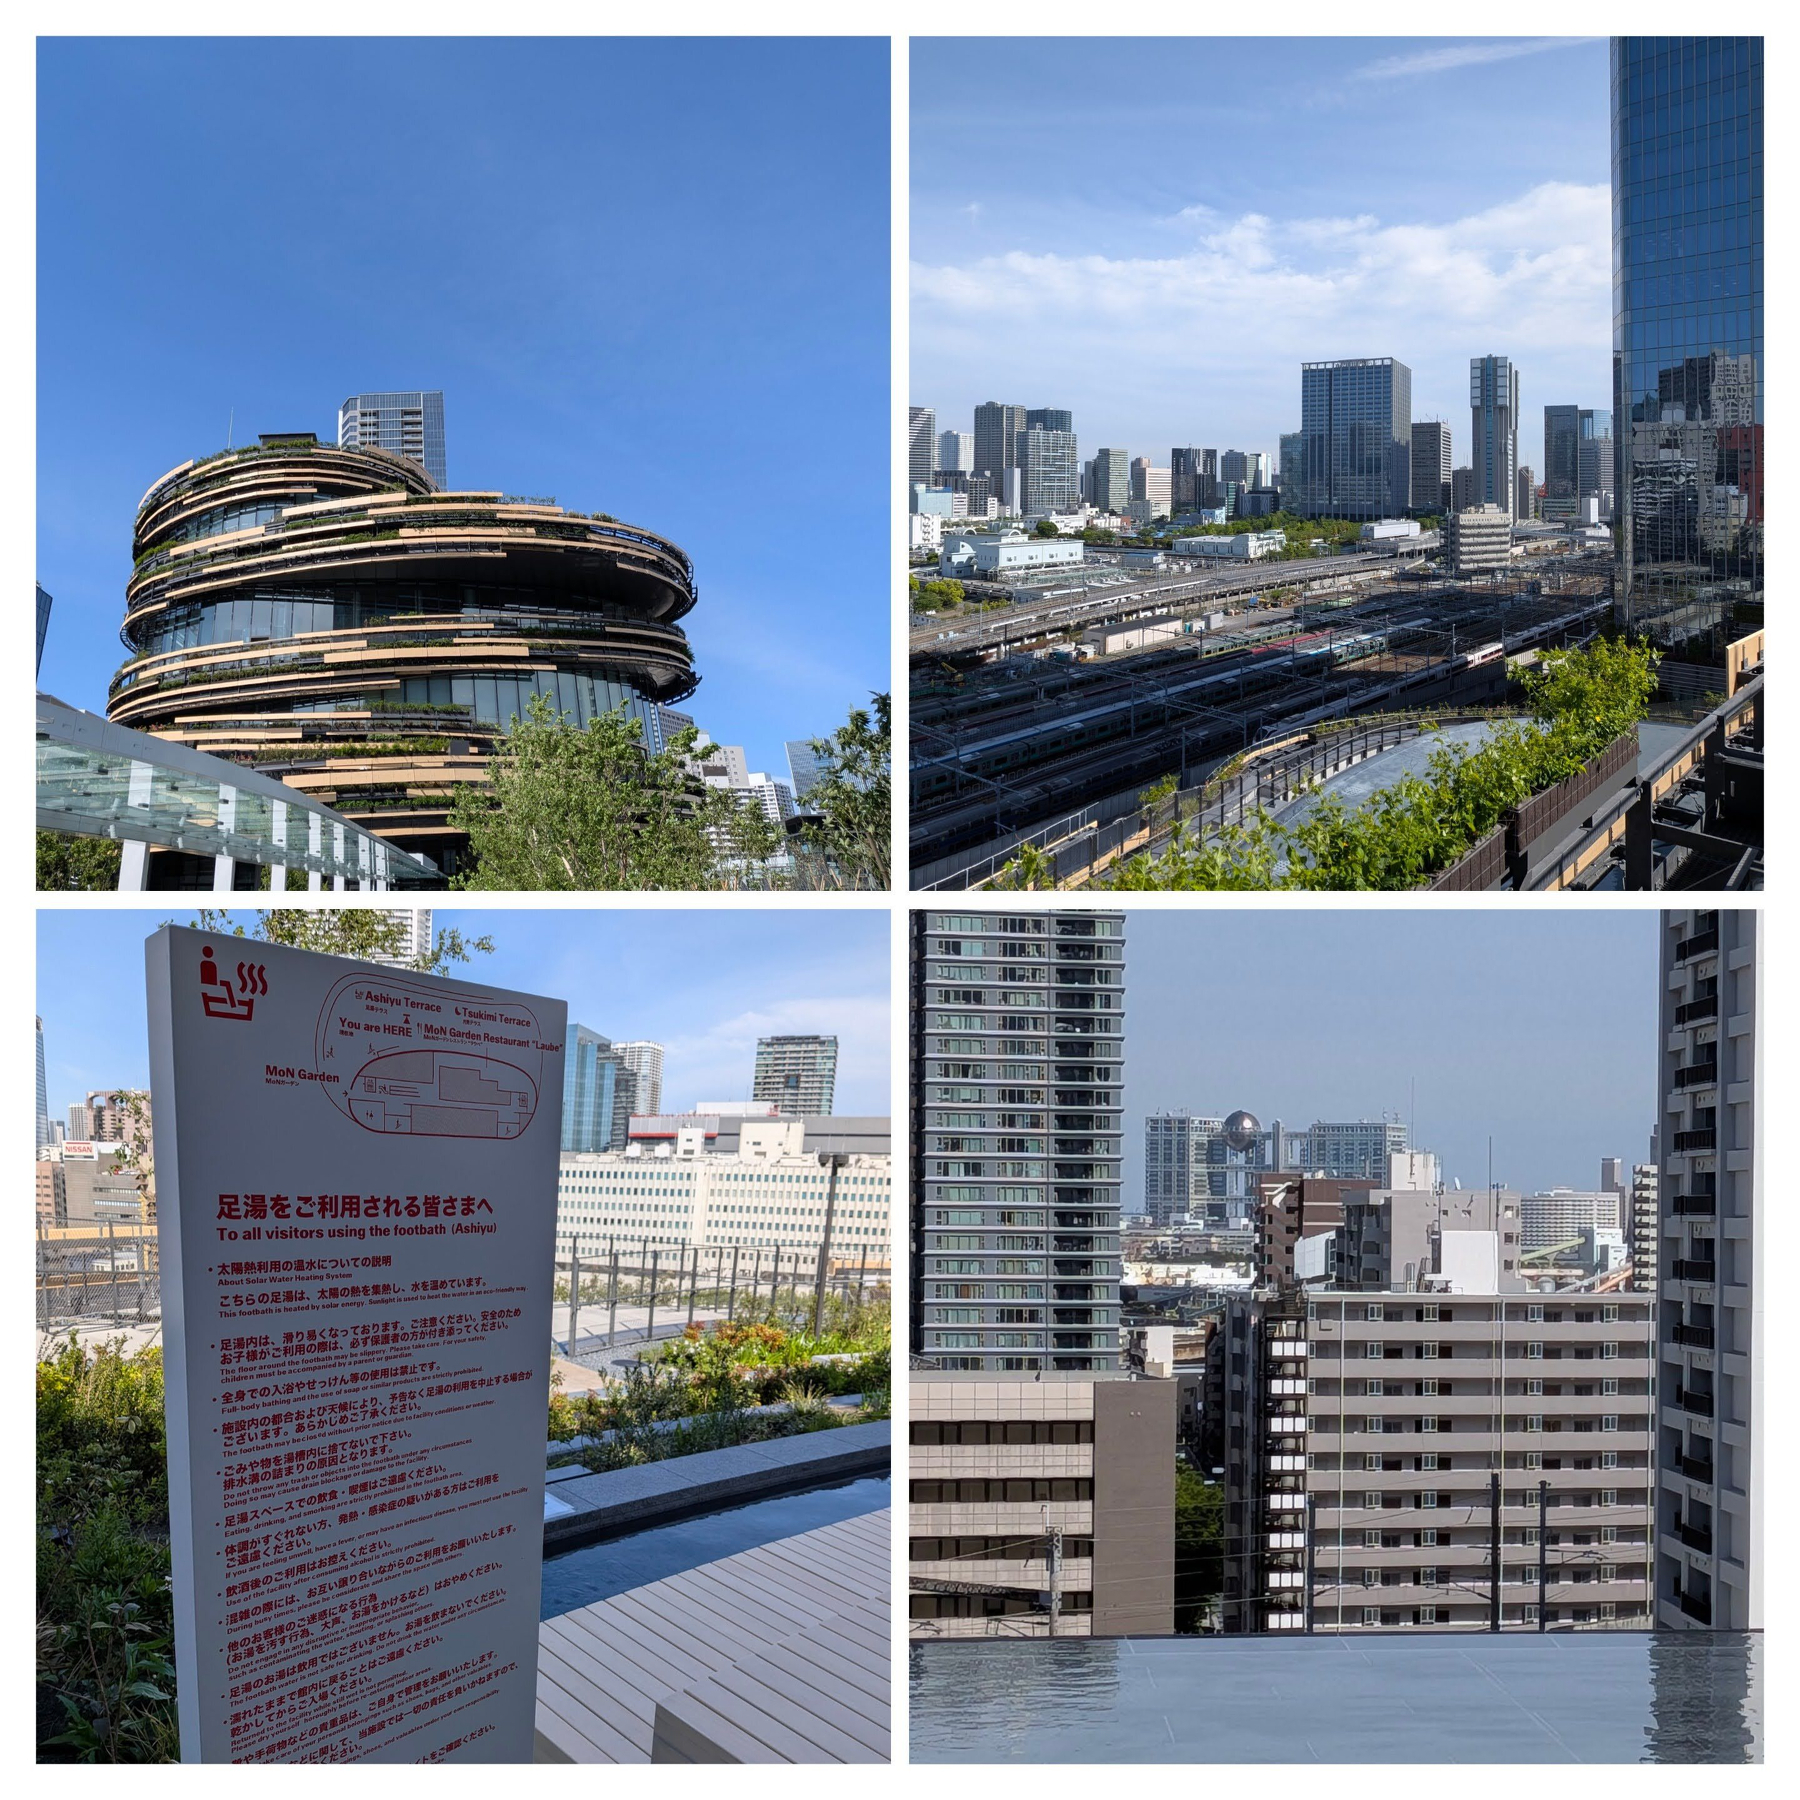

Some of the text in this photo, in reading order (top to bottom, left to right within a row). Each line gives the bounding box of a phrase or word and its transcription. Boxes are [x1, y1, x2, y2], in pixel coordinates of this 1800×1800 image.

[365, 991, 442, 1013] Ashiyu Terrace
[339, 1016, 413, 1038] You are HERE
[462, 1007, 531, 1027] Tsukimi Terrace
[424, 1023, 448, 1036] MoN
[449, 1027, 481, 1042] Garden
[483, 1032, 530, 1048] Restaurant
[265, 1064, 340, 1084] MoN Garden
[65, 1145, 93, 1154] NISSAN
[216, 1194, 493, 1220] 足湯をご利用される皆さまへ
[217, 1221, 497, 1241] To all visitors using the footbath (Ashiyu)
[217, 1279, 244, 1287] About
[245, 1277, 267, 1285] Solar
[218, 1309, 237, 1318] This
[238, 1307, 273, 1316] footbath
[283, 1304, 310, 1313] heated
[311, 1303, 320, 1311] by
[220, 1368, 236, 1376] The
[258, 1360, 286, 1370] around
[301, 1355, 333, 1364] footbath
[220, 1374, 254, 1384] children
[256, 1370, 275, 1379] must
[288, 1361, 337, 1374] accompanied
[262, 1398, 291, 1408] bathing
[292, 1394, 306, 1403] and
[335, 1388, 342, 1396] of
[222, 1450, 238, 1458] The
[239, 1442, 273, 1455] footbath
[327, 1426, 354, 1436] without
[223, 1498, 247, 1509] Doing
[260, 1492, 276, 1500] may
[277, 1486, 300, 1495] cause
[301, 1481, 319, 1490] drain
[320, 1473, 352, 1485] blockage
[237, 1489, 250, 1497] not
[252, 1485, 274, 1494] throw
[290, 1475, 310, 1484] trash
[320, 1468, 346, 1478] objects
[288, 1511, 302, 1521] and
[232, 1568, 247, 1578] you
[248, 1564, 261, 1572] are
[262, 1557, 287, 1568] feeling
[315, 1543, 332, 1552] have
[226, 1598, 241, 1607] Use
[243, 1594, 251, 1602] of
[267, 1582, 292, 1594] facility
[293, 1576, 310, 1586] after
[311, 1564, 349, 1580] consuming
[227, 1622, 253, 1635] During
[254, 1616, 272, 1625] busy
[297, 1600, 320, 1612] please
[228, 1666, 239, 1674] Do
[241, 1661, 253, 1670] not
[255, 1650, 282, 1664] engage
[291, 1643, 304, 1651] any
[305, 1630, 339, 1646] disruptive
[228, 1670, 247, 1681] such
[259, 1648, 310, 1670] contaminating
[230, 1699, 244, 1707] The
[245, 1685, 277, 1702] footbath
[278, 1678, 299, 1689] water
[307, 1669, 319, 1678] not
[320, 1664, 335, 1673] safe
[336, 1659, 346, 1667] for
[231, 1728, 265, 1747] Returned
[231, 1740, 256, 1756] Please
